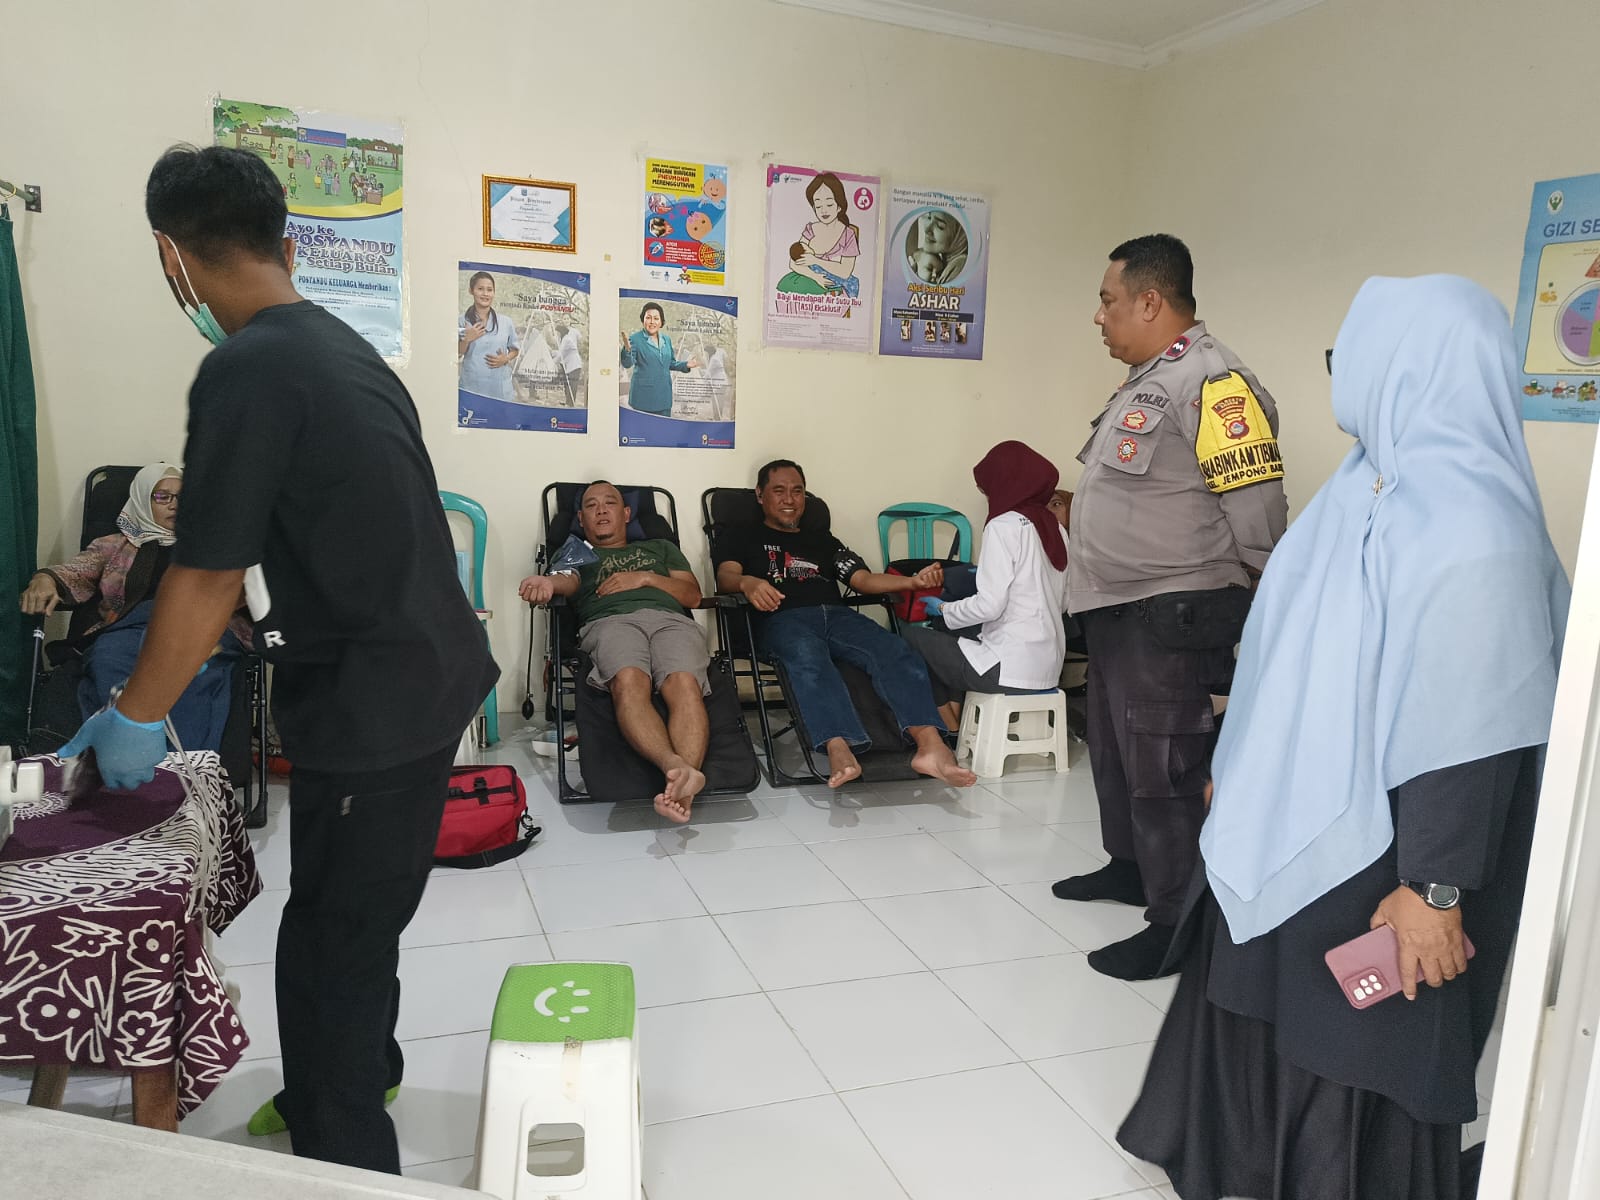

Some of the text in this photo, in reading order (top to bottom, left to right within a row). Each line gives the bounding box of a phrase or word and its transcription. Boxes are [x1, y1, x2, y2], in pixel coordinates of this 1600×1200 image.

[287, 221, 335, 236] Ayo ke
[1543, 221, 1576, 238] GIZI
[287, 232, 395, 256] POSYANDU
[297, 246, 389, 266] KELUARGA
[306, 256, 397, 276] Setiap Bulan
[298, 275, 328, 286] POSYANDU
[329, 278, 358, 288] KELUARGA
[926, 284, 949, 294] Seribu
[777, 293, 862, 306] Bayi Mendapat Air Susu Ibu
[798, 302, 842, 313] (ASI) Eksklusif
[909, 293, 960, 310] ASHAR
[1222, 466, 1267, 485] JEMPONG
[763, 544, 782, 552] FREE
[263, 630, 288, 648] R
